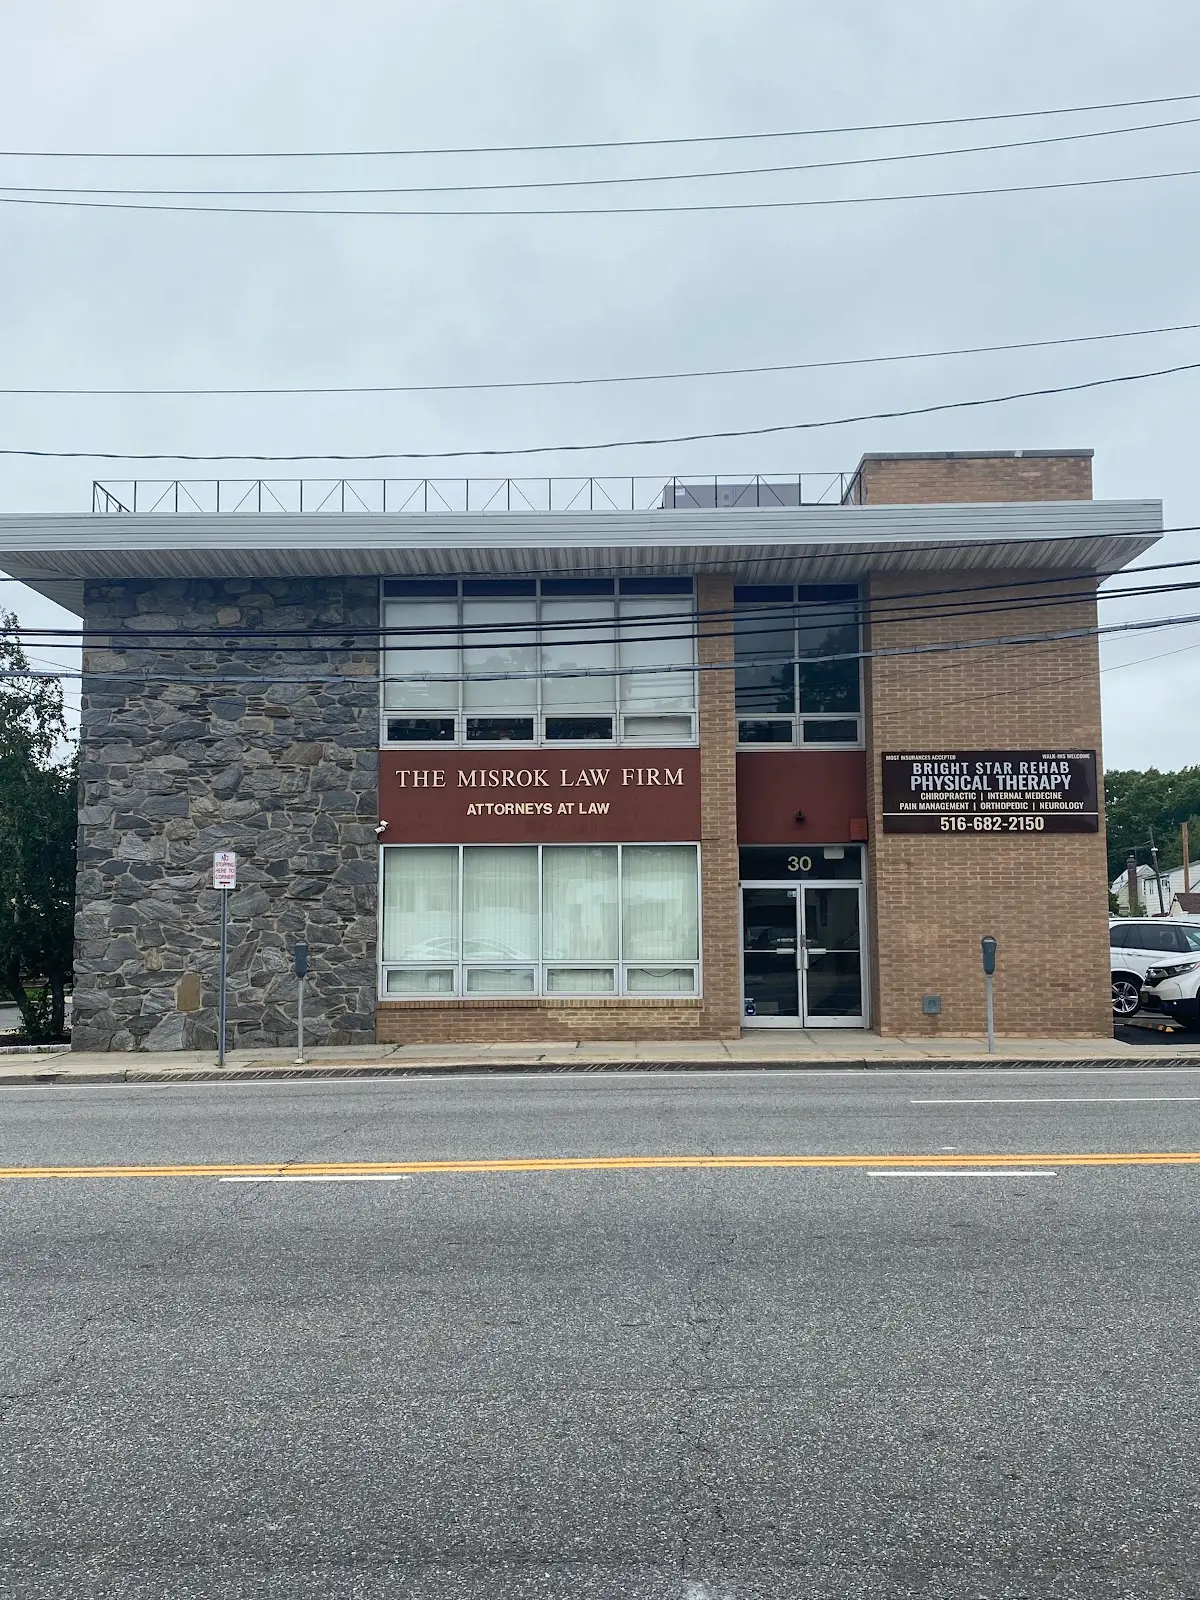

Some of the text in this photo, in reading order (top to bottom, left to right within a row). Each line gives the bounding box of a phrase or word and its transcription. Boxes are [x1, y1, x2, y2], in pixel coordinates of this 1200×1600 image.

[913, 761, 1069, 775] BRIGHT STAR REHAB
[395, 768, 685, 788] THE MISROK LAW FIRM
[910, 774, 1072, 791] PHYSICAL THERAPY
[920, 791, 1062, 800] CHIROPRACTIC INTERNAL MEDECINE
[466, 802, 611, 816] ATTORNEYS AT LAW
[899, 801, 1084, 810] PAIN MANAGEMENT ORTHOPEDIC NEUROLOGY
[940, 816, 1044, 831] 516-682-2150
[787, 856, 812, 871] 30
